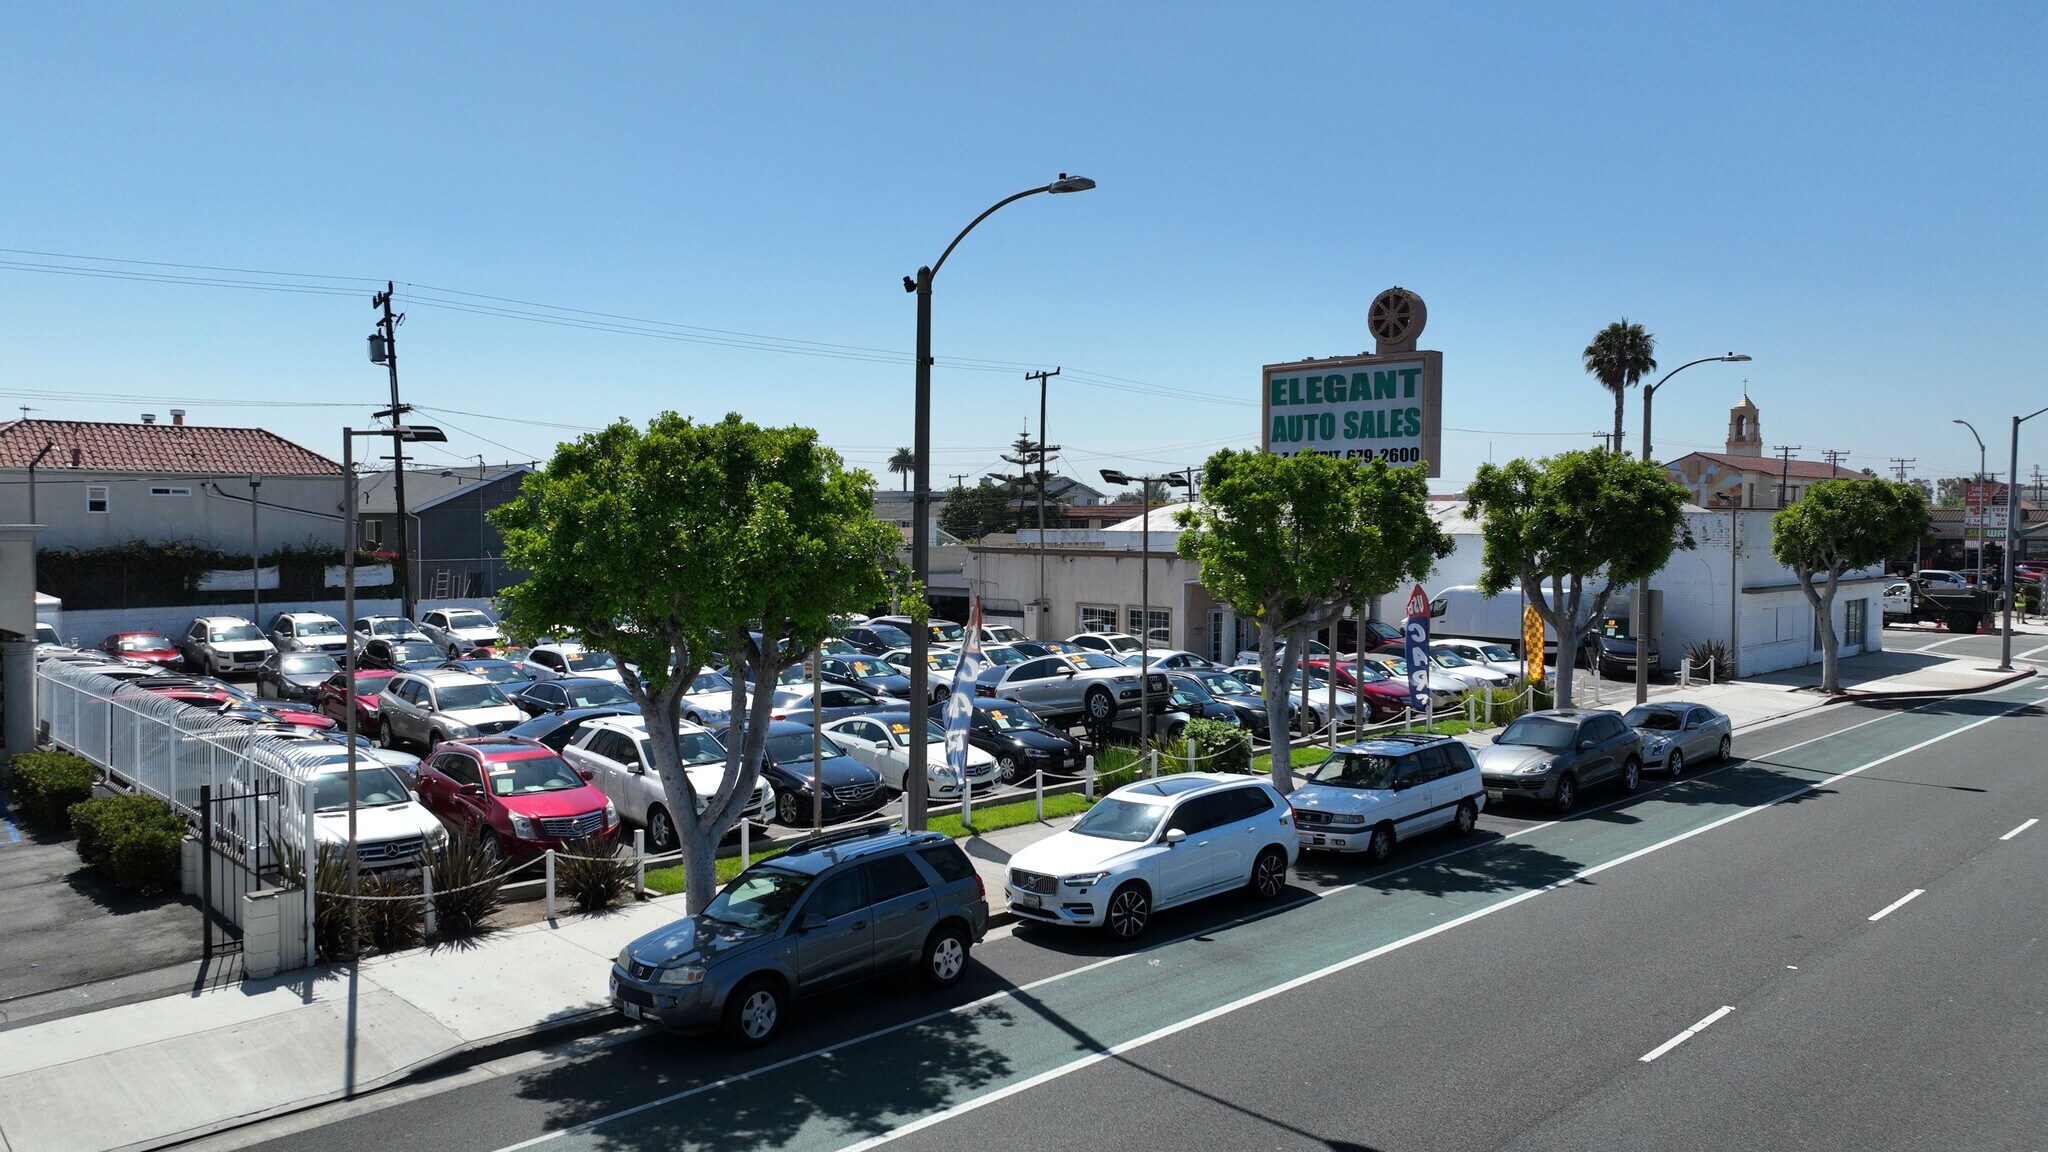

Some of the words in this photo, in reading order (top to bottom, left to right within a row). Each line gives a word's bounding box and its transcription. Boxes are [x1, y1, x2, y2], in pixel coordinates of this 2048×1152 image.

[1271, 368, 1422, 406] ELEGANT
[1271, 412, 1336, 443] AUTO
[1343, 407, 1421, 440] SALES
[1346, 447, 1419, 463] 679-2600
